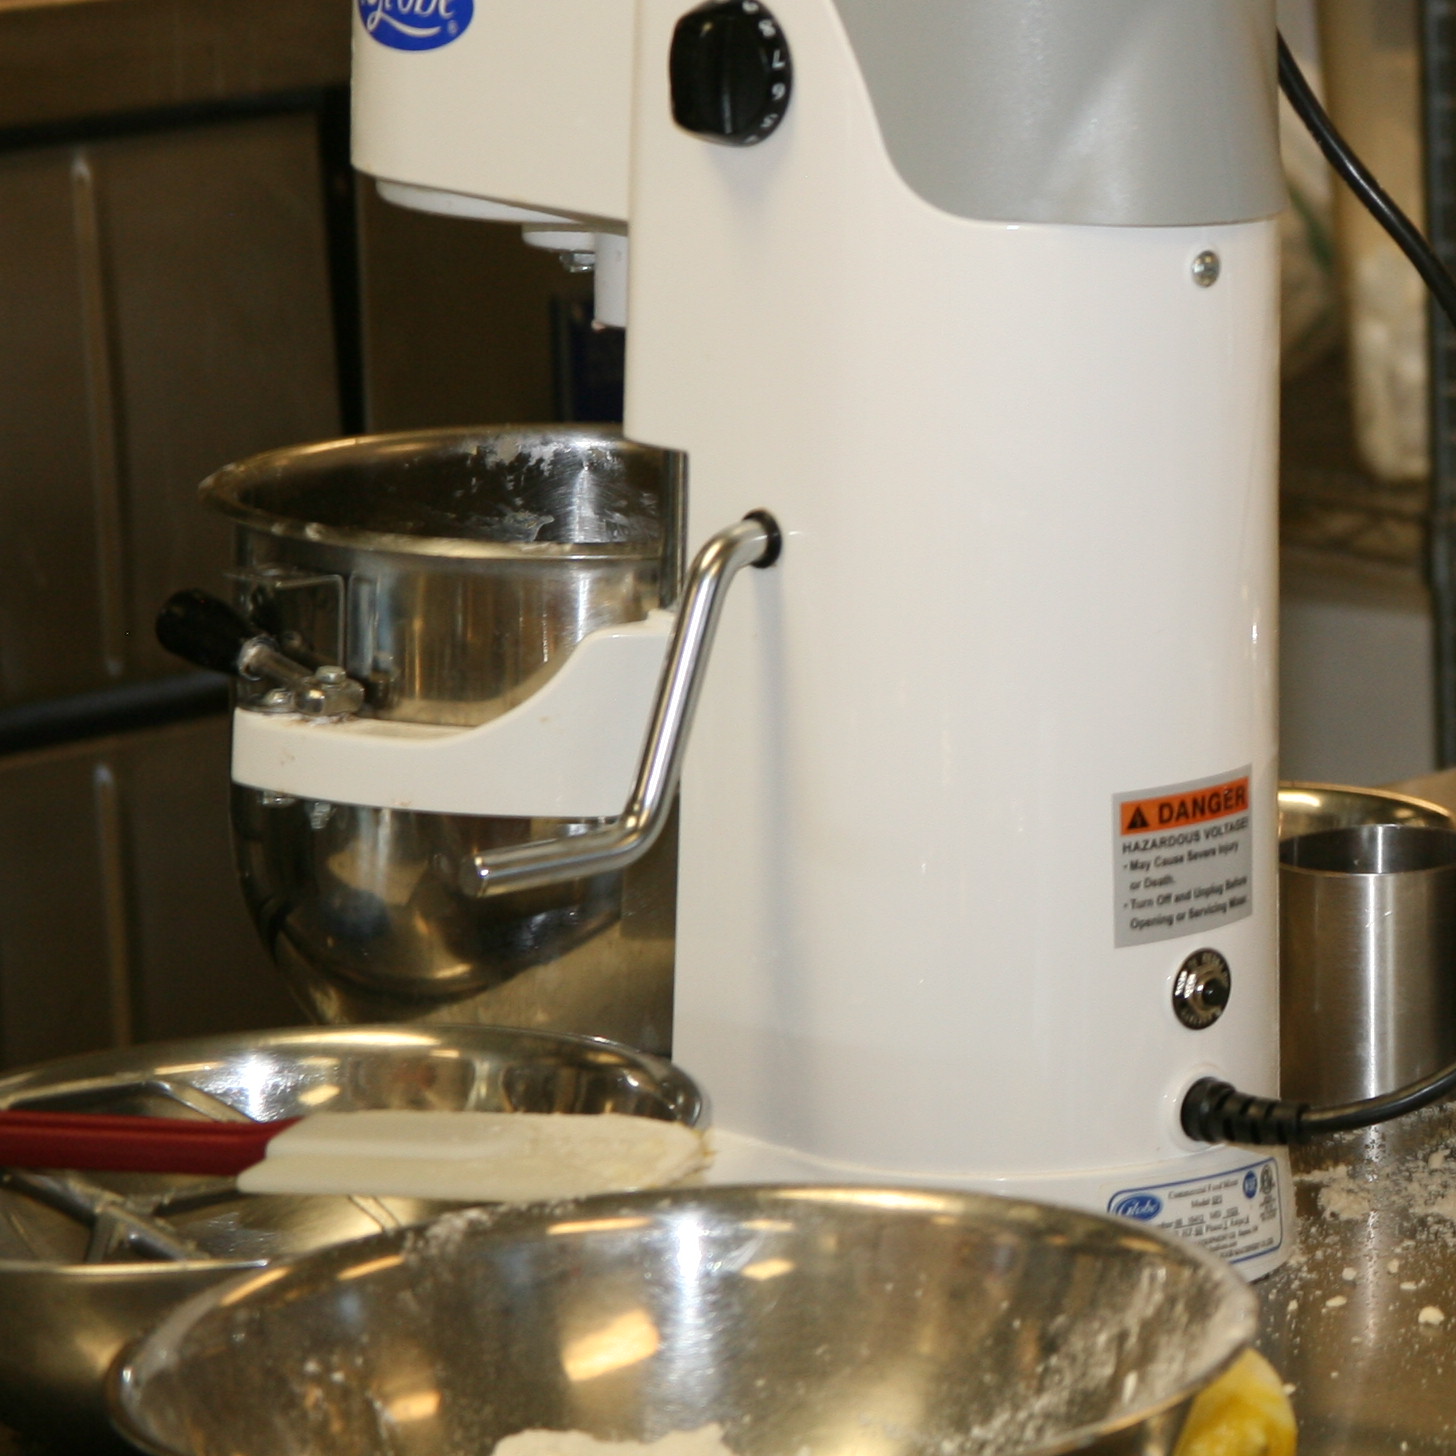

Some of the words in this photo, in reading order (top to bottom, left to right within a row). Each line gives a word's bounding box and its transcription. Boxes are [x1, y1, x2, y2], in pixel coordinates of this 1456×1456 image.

[1158, 784, 1247, 825] DANGER
[1122, 830, 1200, 853] HAZARDOUS
[1130, 859, 1151, 872] May
[1154, 855, 1184, 868] Cause
[1187, 848, 1216, 861] Severe
[1130, 881, 1141, 890] or
[1130, 897, 1153, 909] Turn
[1175, 890, 1191, 903] and
[1129, 913, 1174, 930] Opening
